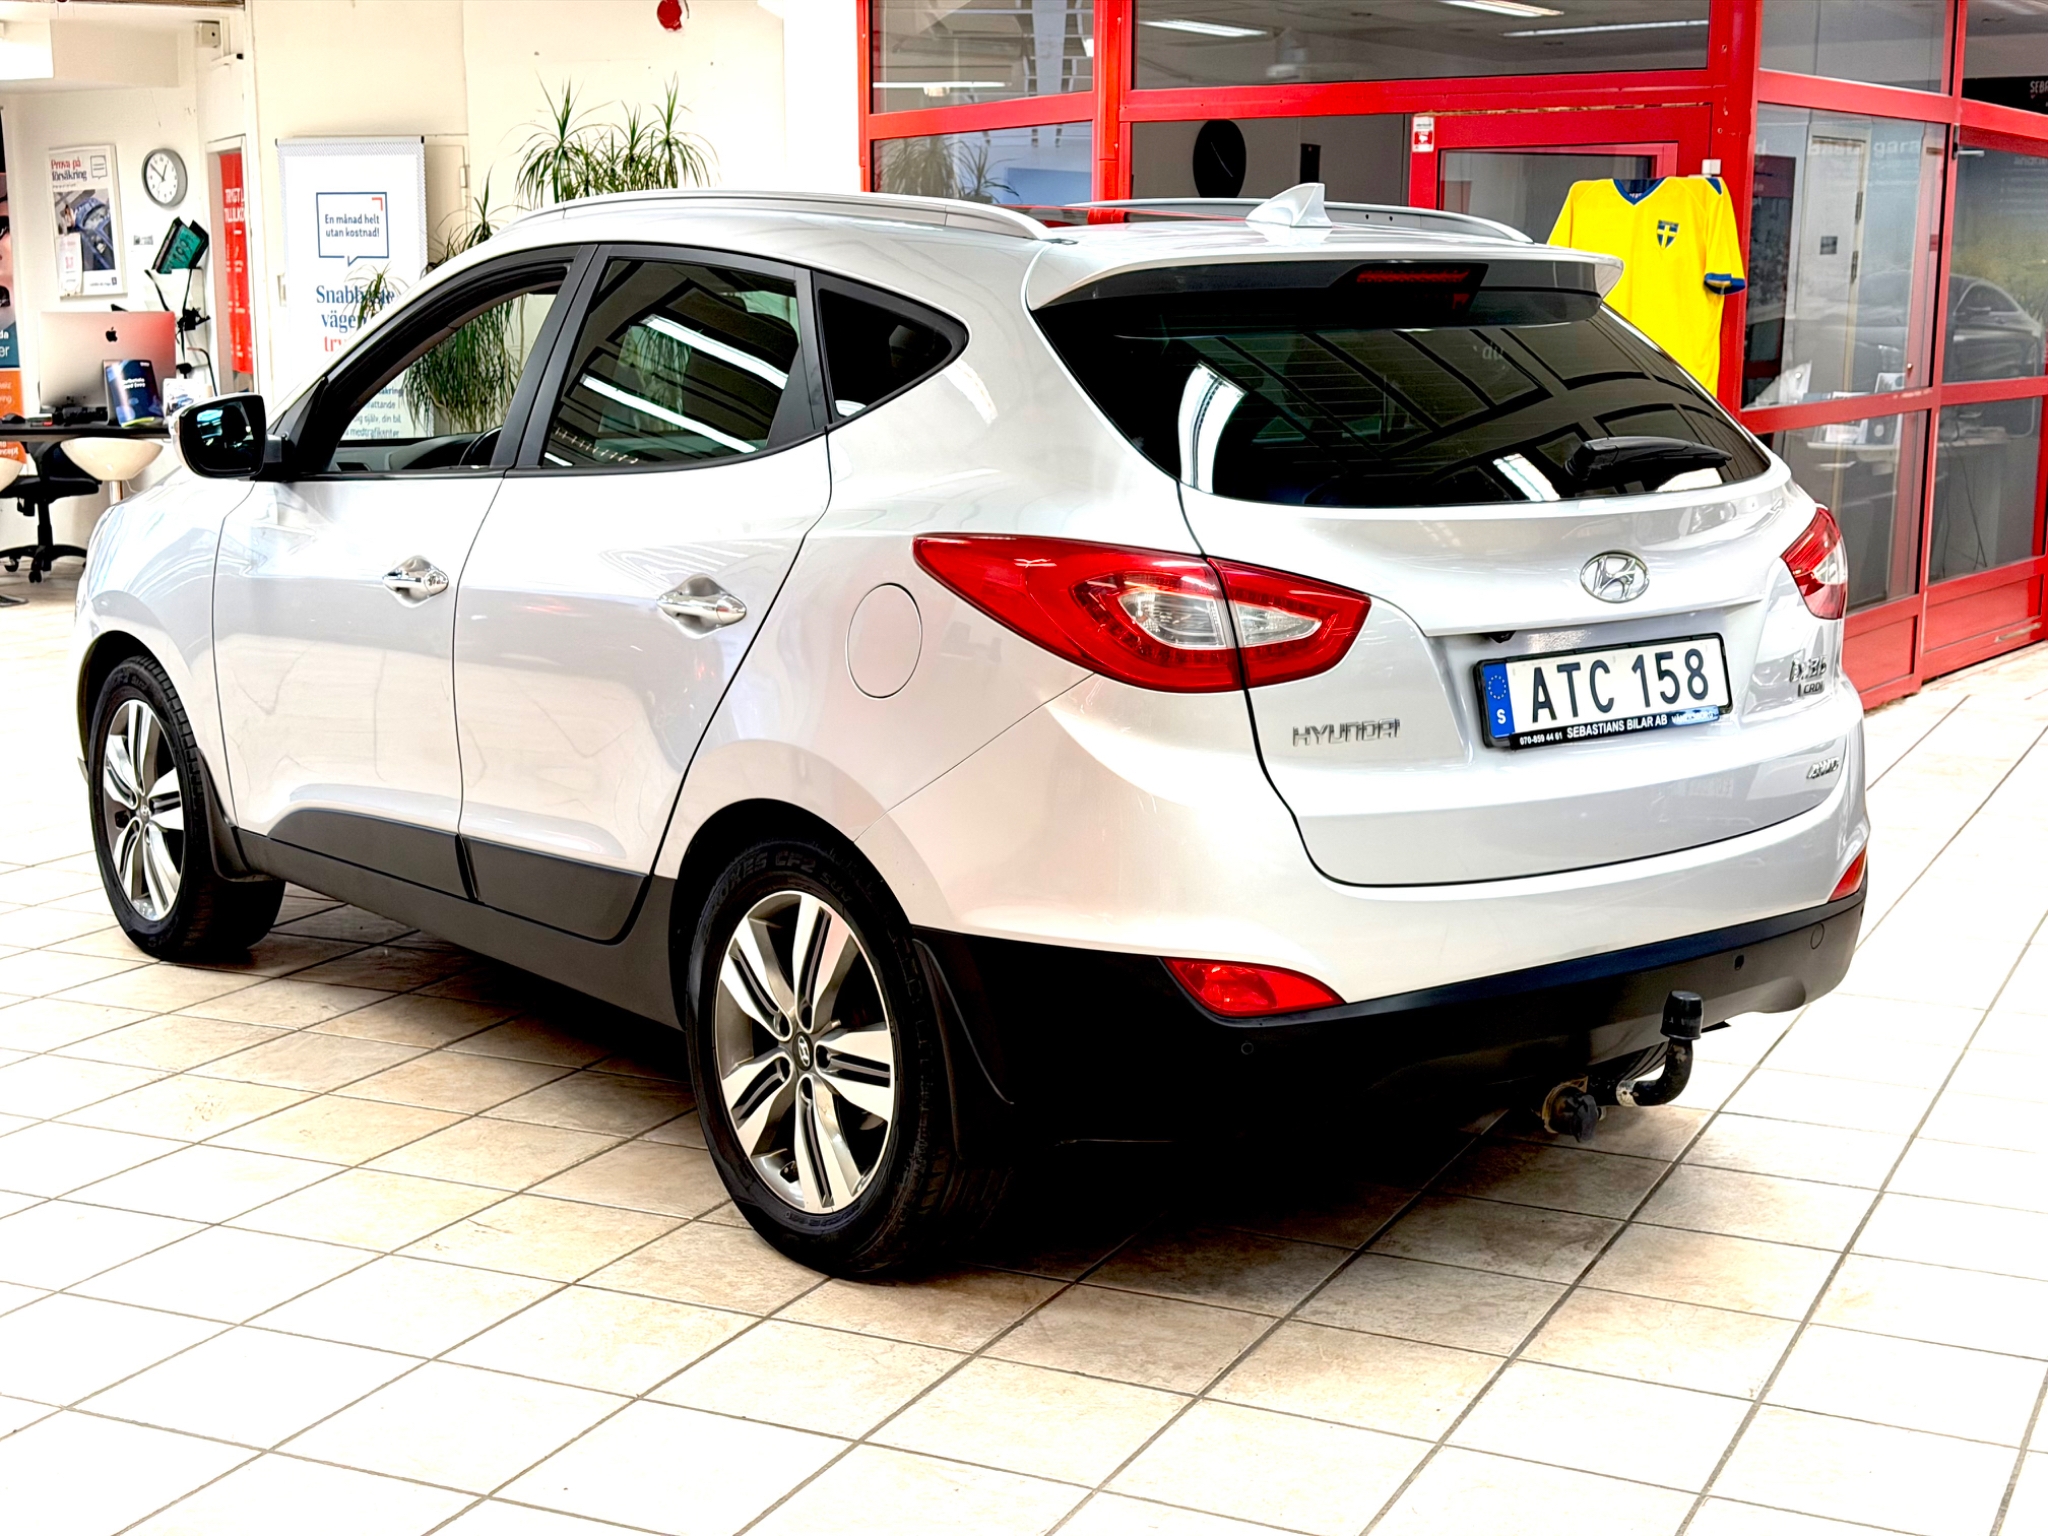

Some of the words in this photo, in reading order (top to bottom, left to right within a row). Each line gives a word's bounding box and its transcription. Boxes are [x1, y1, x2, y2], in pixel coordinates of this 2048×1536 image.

[72, 156, 81, 171] på
[325, 213, 335, 225] En
[336, 213, 363, 225] månad
[364, 213, 380, 225] helt
[325, 228, 344, 238] utan
[345, 226, 380, 238] kostnad!
[1531, 659, 1615, 724] ATC
[1631, 648, 1710, 708] 158
[1496, 708, 1507, 724] S
[1292, 718, 1401, 747] HYUNDAI
[1546, 731, 1555, 742] 44
[1566, 719, 1625, 739] SEBASTIANS
[1626, 715, 1654, 731] BILAR
[1654, 713, 1668, 727] AB
